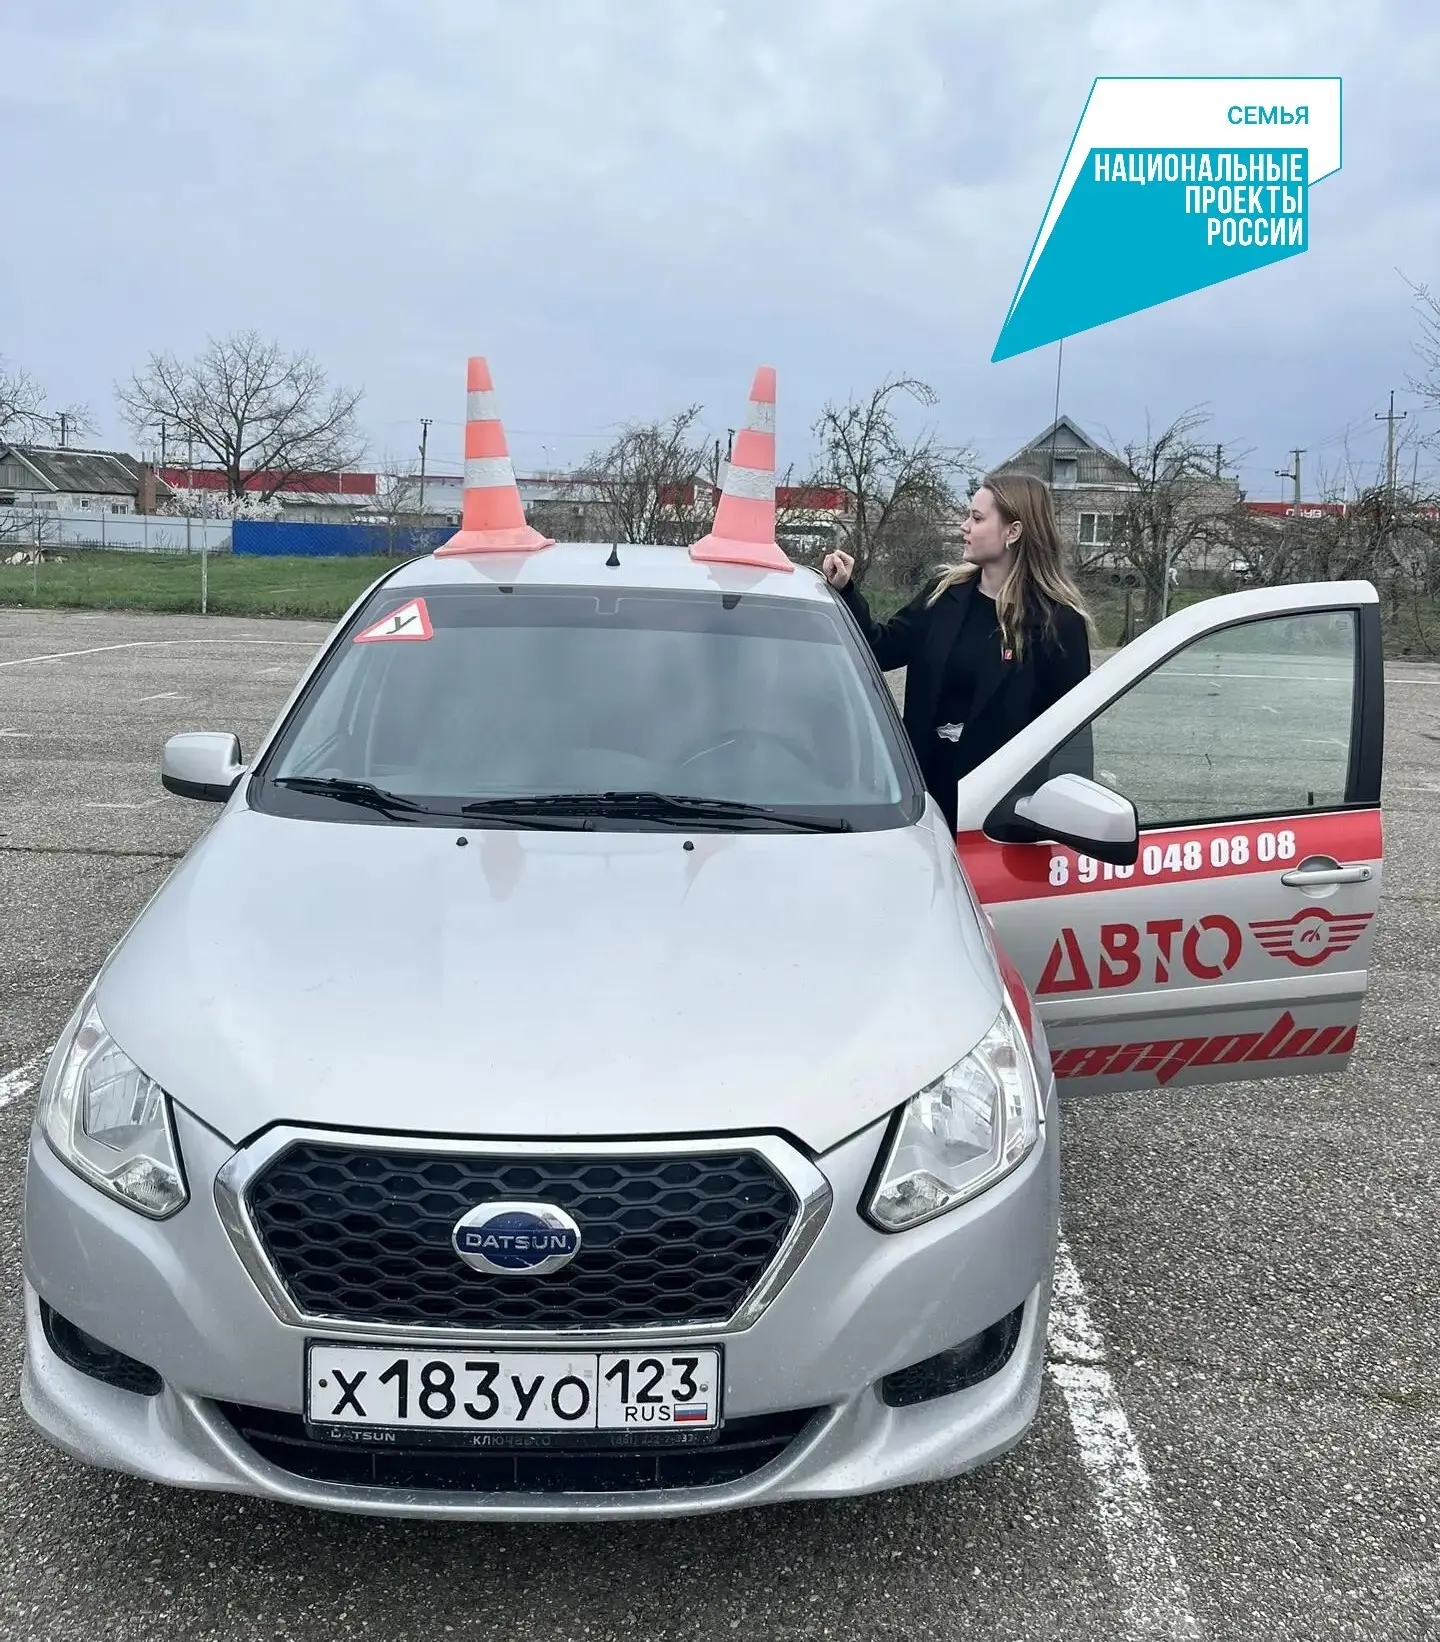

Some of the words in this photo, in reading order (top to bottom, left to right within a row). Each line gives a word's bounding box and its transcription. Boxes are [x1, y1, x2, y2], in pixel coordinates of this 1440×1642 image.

[386, 616, 418, 634] У
[1048, 855, 1070, 887] 8
[1142, 840, 1203, 876] 048
[1210, 835, 1250, 868] 08
[1257, 830, 1296, 862] 08
[1035, 914, 1242, 995] АВТО
[465, 1233, 567, 1250] DATSUN
[604, 1357, 699, 1404] 123
[624, 1405, 671, 1422] RUS
